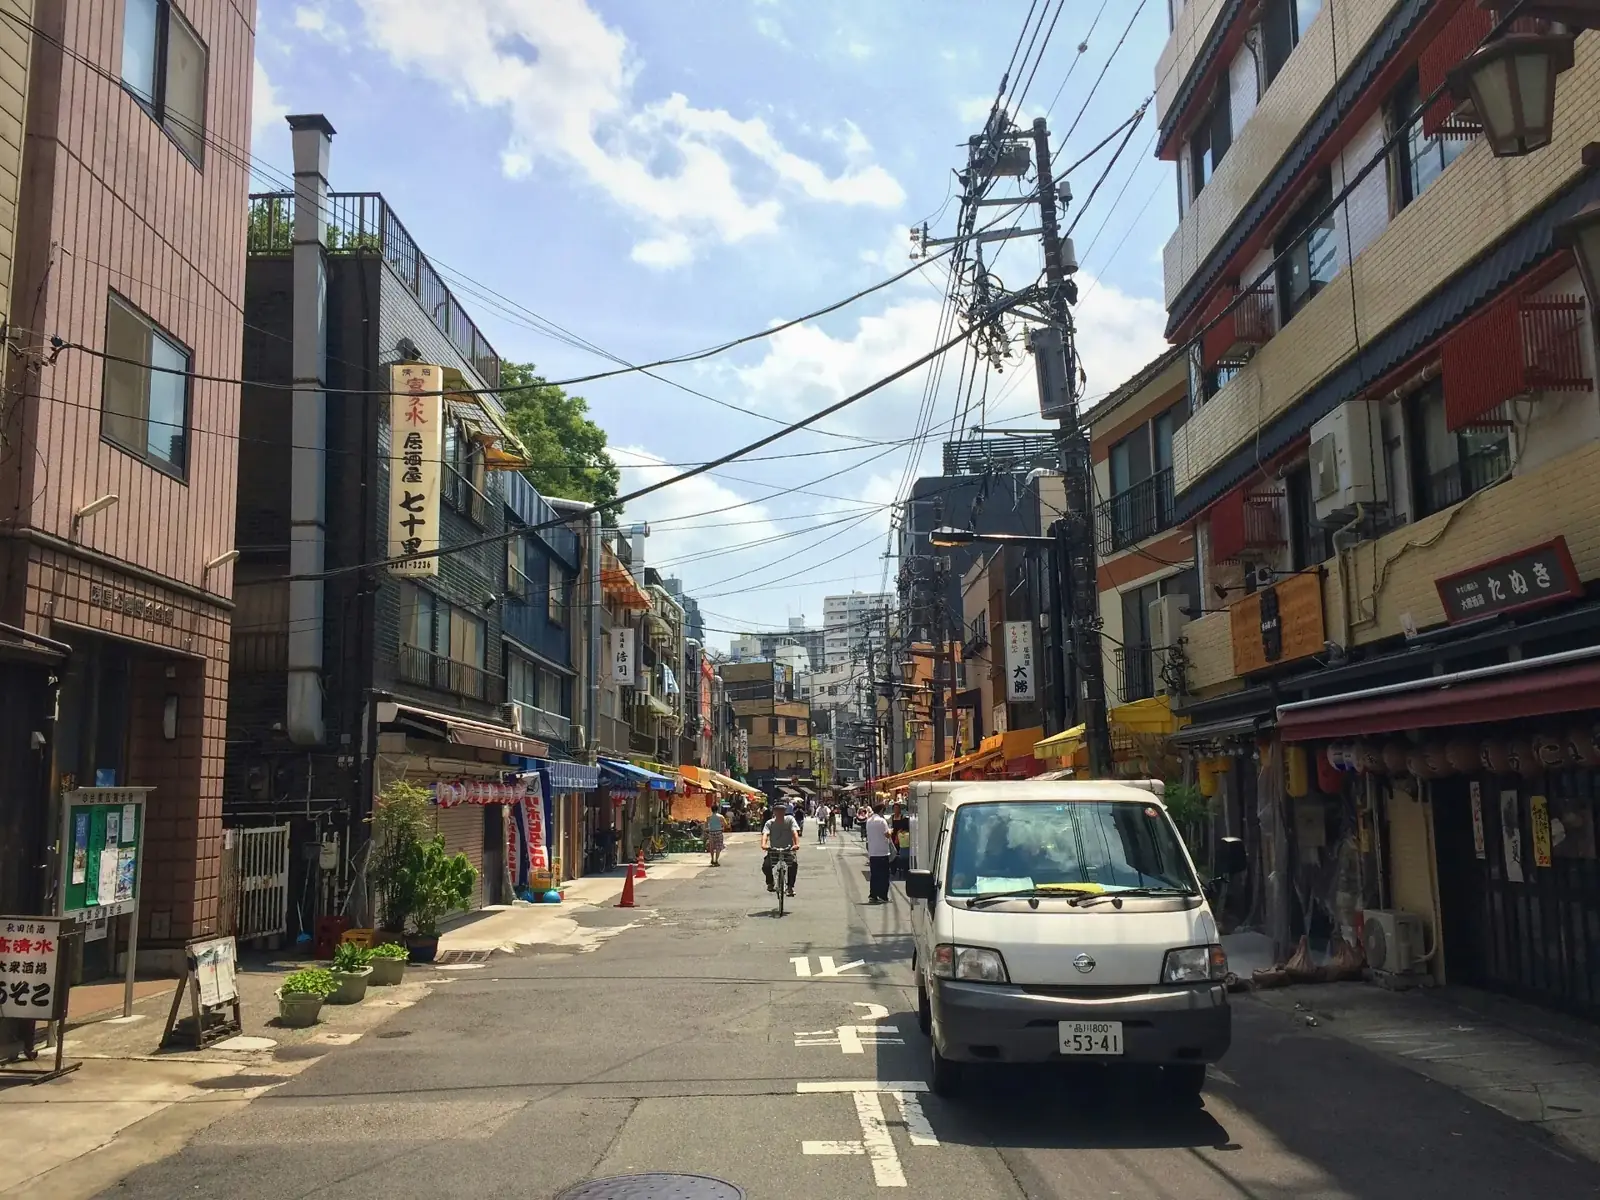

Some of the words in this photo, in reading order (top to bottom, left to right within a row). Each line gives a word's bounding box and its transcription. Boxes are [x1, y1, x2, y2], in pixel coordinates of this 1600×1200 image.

[402, 432, 423, 483] 居酒屋
[1486, 562, 1551, 601] たぬき
[1013, 664, 1028, 694] 大勝
[7, 922, 46, 934] 秋田清酒
[1073, 1034, 1118, 1052] 53-41
